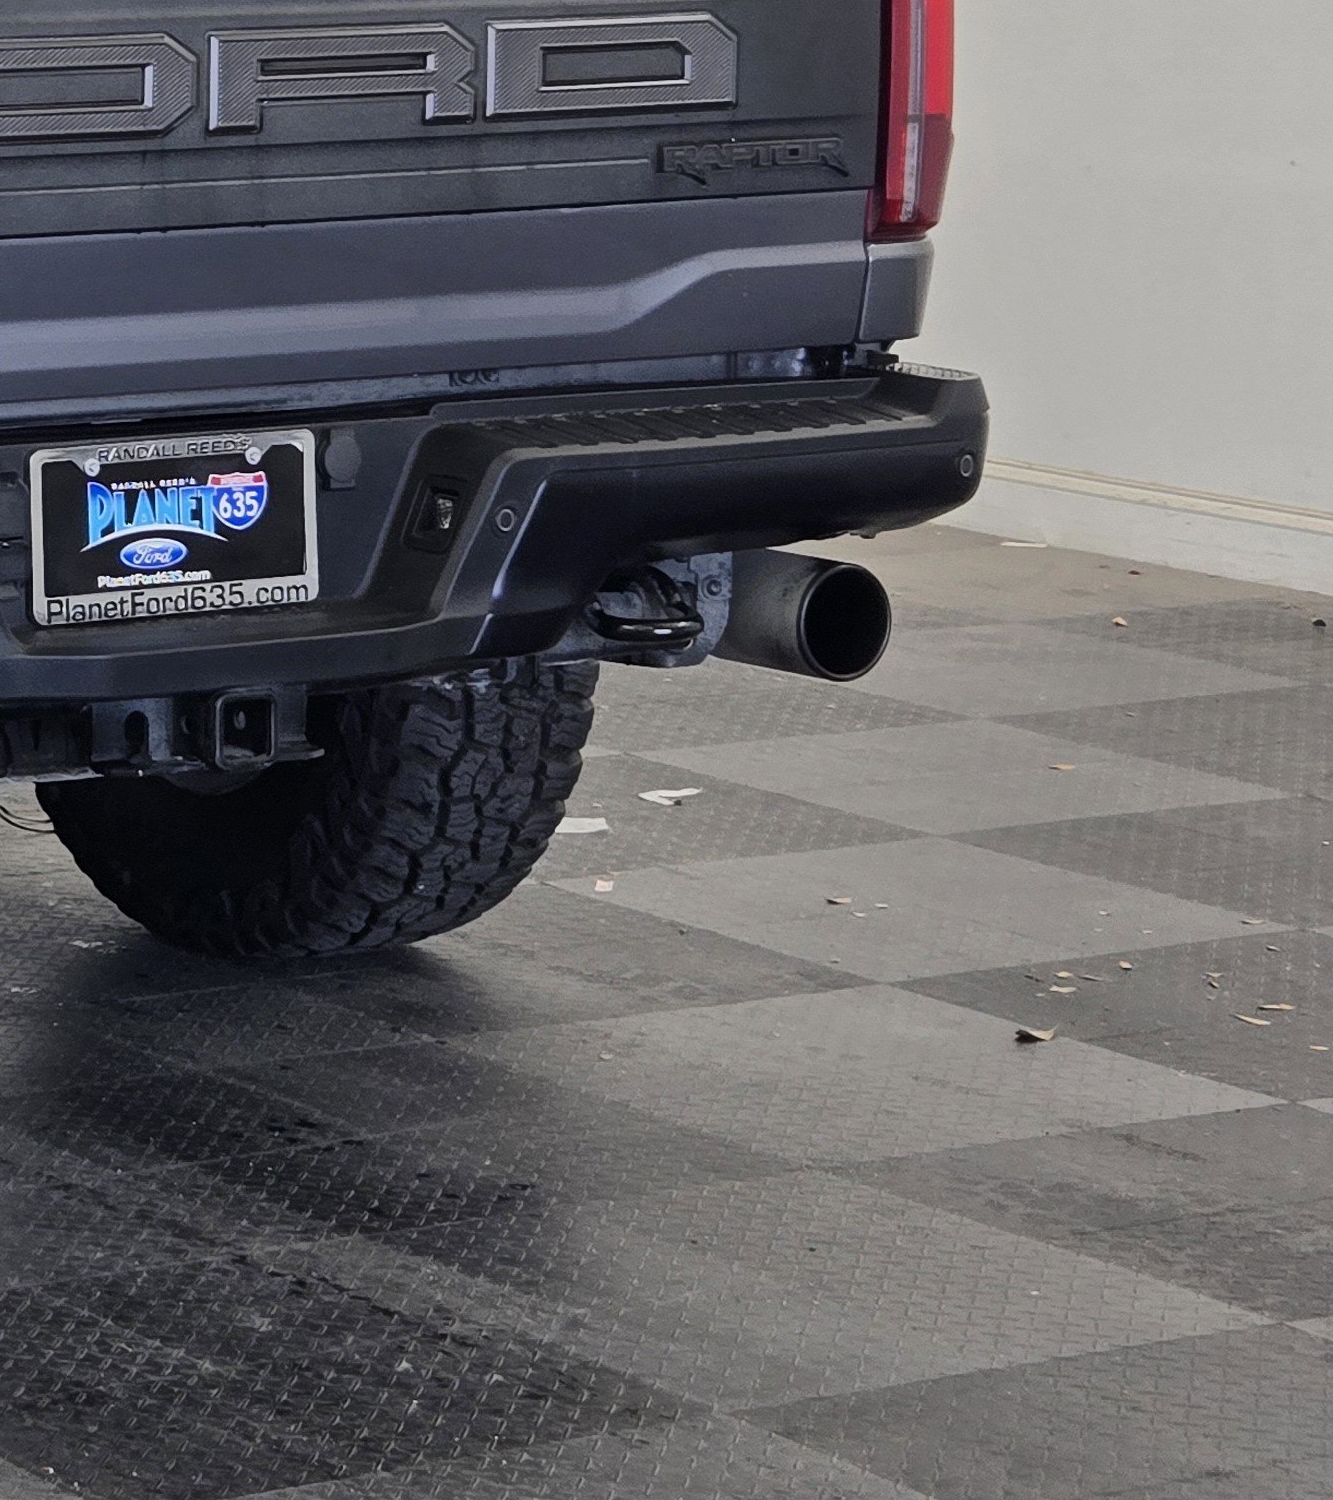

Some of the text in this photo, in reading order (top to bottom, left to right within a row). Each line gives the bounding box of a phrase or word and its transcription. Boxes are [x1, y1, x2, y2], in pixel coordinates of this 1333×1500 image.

[658, 136, 850, 187] RAPTOR
[98, 444, 182, 463] RANDALL
[87, 482, 218, 546] PLANET
[219, 491, 259, 519] 635
[133, 544, 173, 565] Ford
[46, 582, 309, 624] PlanetFord635.com
